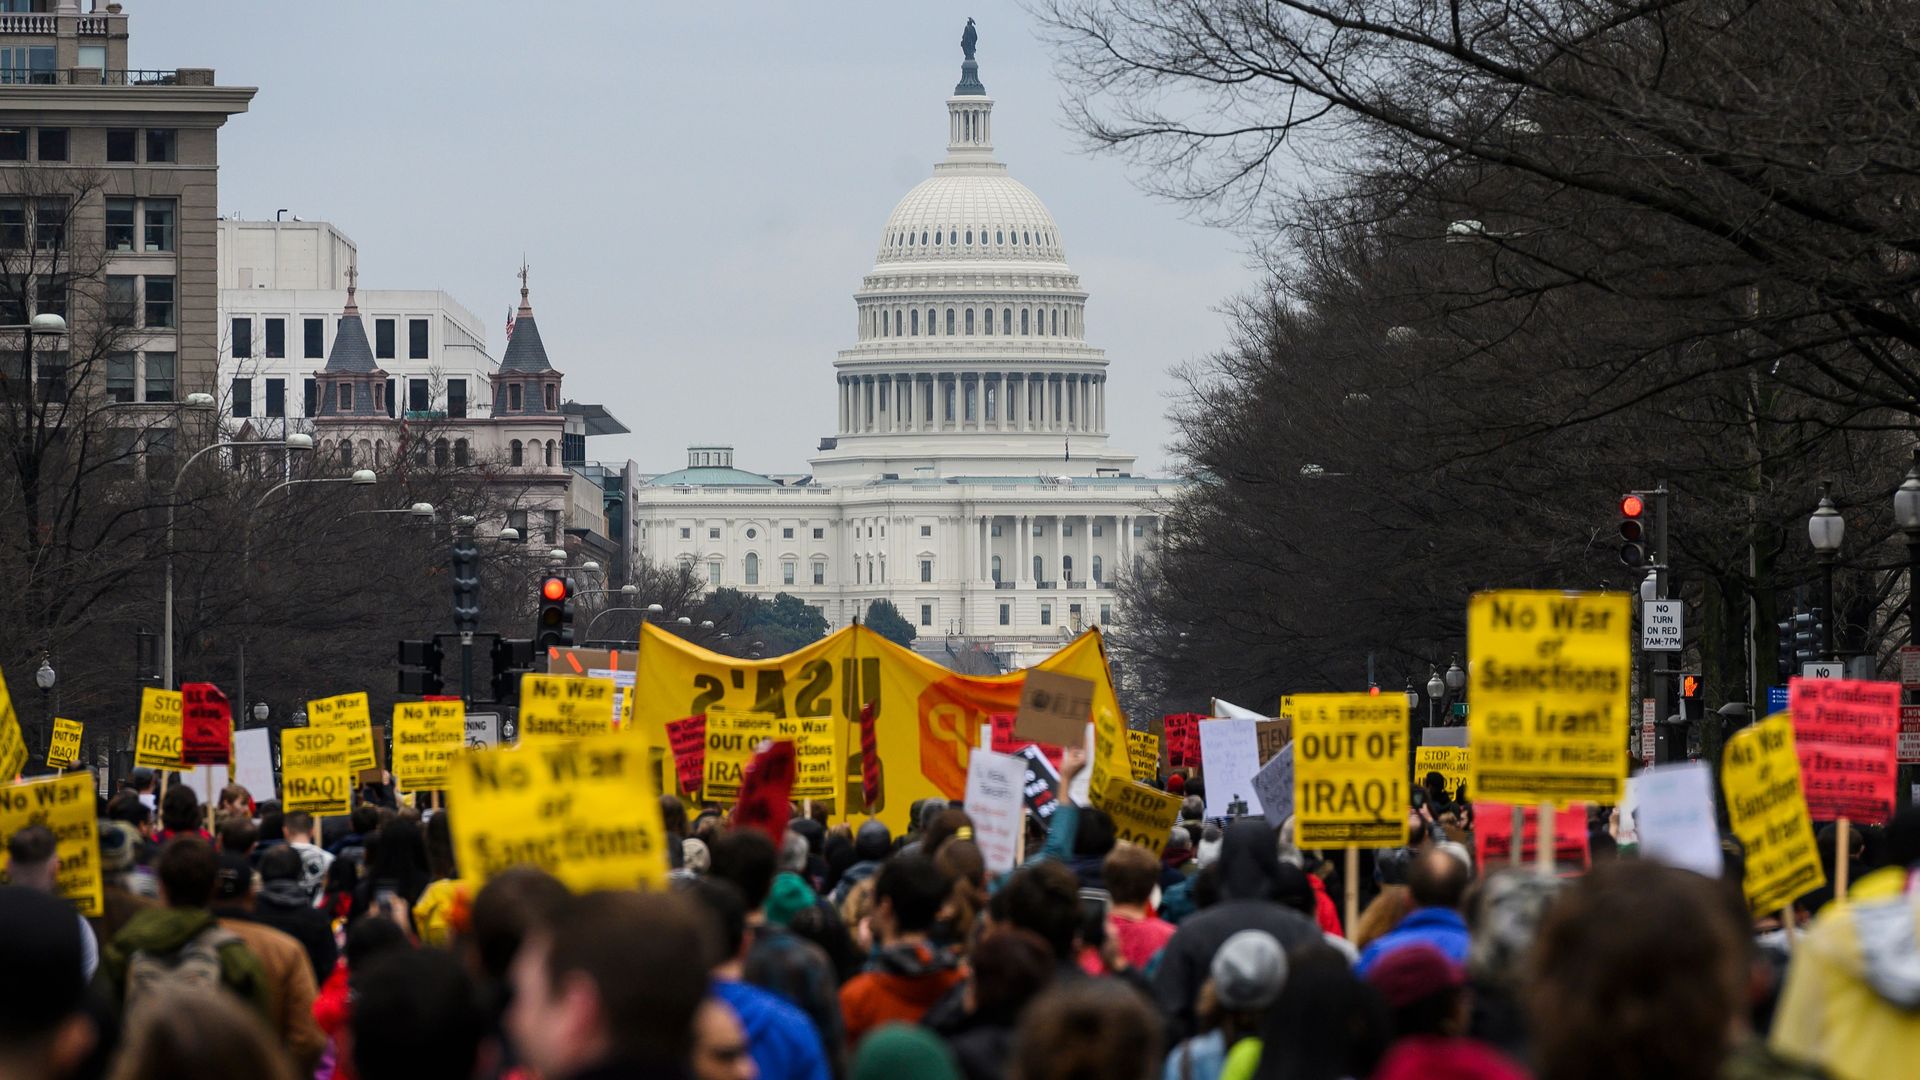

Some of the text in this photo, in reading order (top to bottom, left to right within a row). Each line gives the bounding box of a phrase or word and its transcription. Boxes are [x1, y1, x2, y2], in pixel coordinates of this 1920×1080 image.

[1491, 599, 1613, 630] No War
[1656, 605, 1669, 613] NO
[1653, 615, 1673, 624] TURN
[1648, 626, 1678, 635] ON RED
[1537, 637, 1565, 657] or
[1480, 656, 1621, 692] Sanctions
[1816, 668, 1830, 678] NO
[533, 681, 604, 698] No War
[1822, 685, 1894, 706] Condemn
[155, 696, 182, 710] STO
[316, 699, 361, 714] No War
[559, 703, 575, 715] or
[403, 706, 456, 719] No War
[1339, 705, 1401, 722] TROOPS
[1486, 704, 1612, 735] on Iran!
[423, 721, 437, 729] or
[526, 715, 607, 737] Sanctions
[779, 721, 828, 734] No War
[1904, 724, 1920, 732] ROUT
[55, 731, 80, 742] OUT OF
[143, 734, 182, 753] IRA
[295, 733, 336, 752] STOP
[400, 731, 461, 745] Sanctions
[709, 735, 744, 751] OUT
[1131, 732, 1156, 745] No War
[1758, 729, 1785, 749] War
[51, 745, 77, 763] IRAQ!
[797, 744, 832, 757] ctions
[1302, 732, 1402, 761] OUT OF
[403, 753, 420, 762] on
[1424, 751, 1450, 761] STOP
[471, 758, 531, 794] No
[543, 746, 626, 784] War
[708, 760, 744, 783] IRA
[798, 761, 831, 774] Iran!
[1138, 758, 1155, 771] Iran!
[1418, 763, 1455, 772] BOMBING
[1815, 754, 1888, 775] Iranian
[35, 782, 82, 807] War
[288, 776, 344, 802] IRAQ!
[1120, 786, 1167, 812] STOP
[1302, 778, 1400, 822] IRAQ!
[1103, 801, 1170, 829] BOMBING
